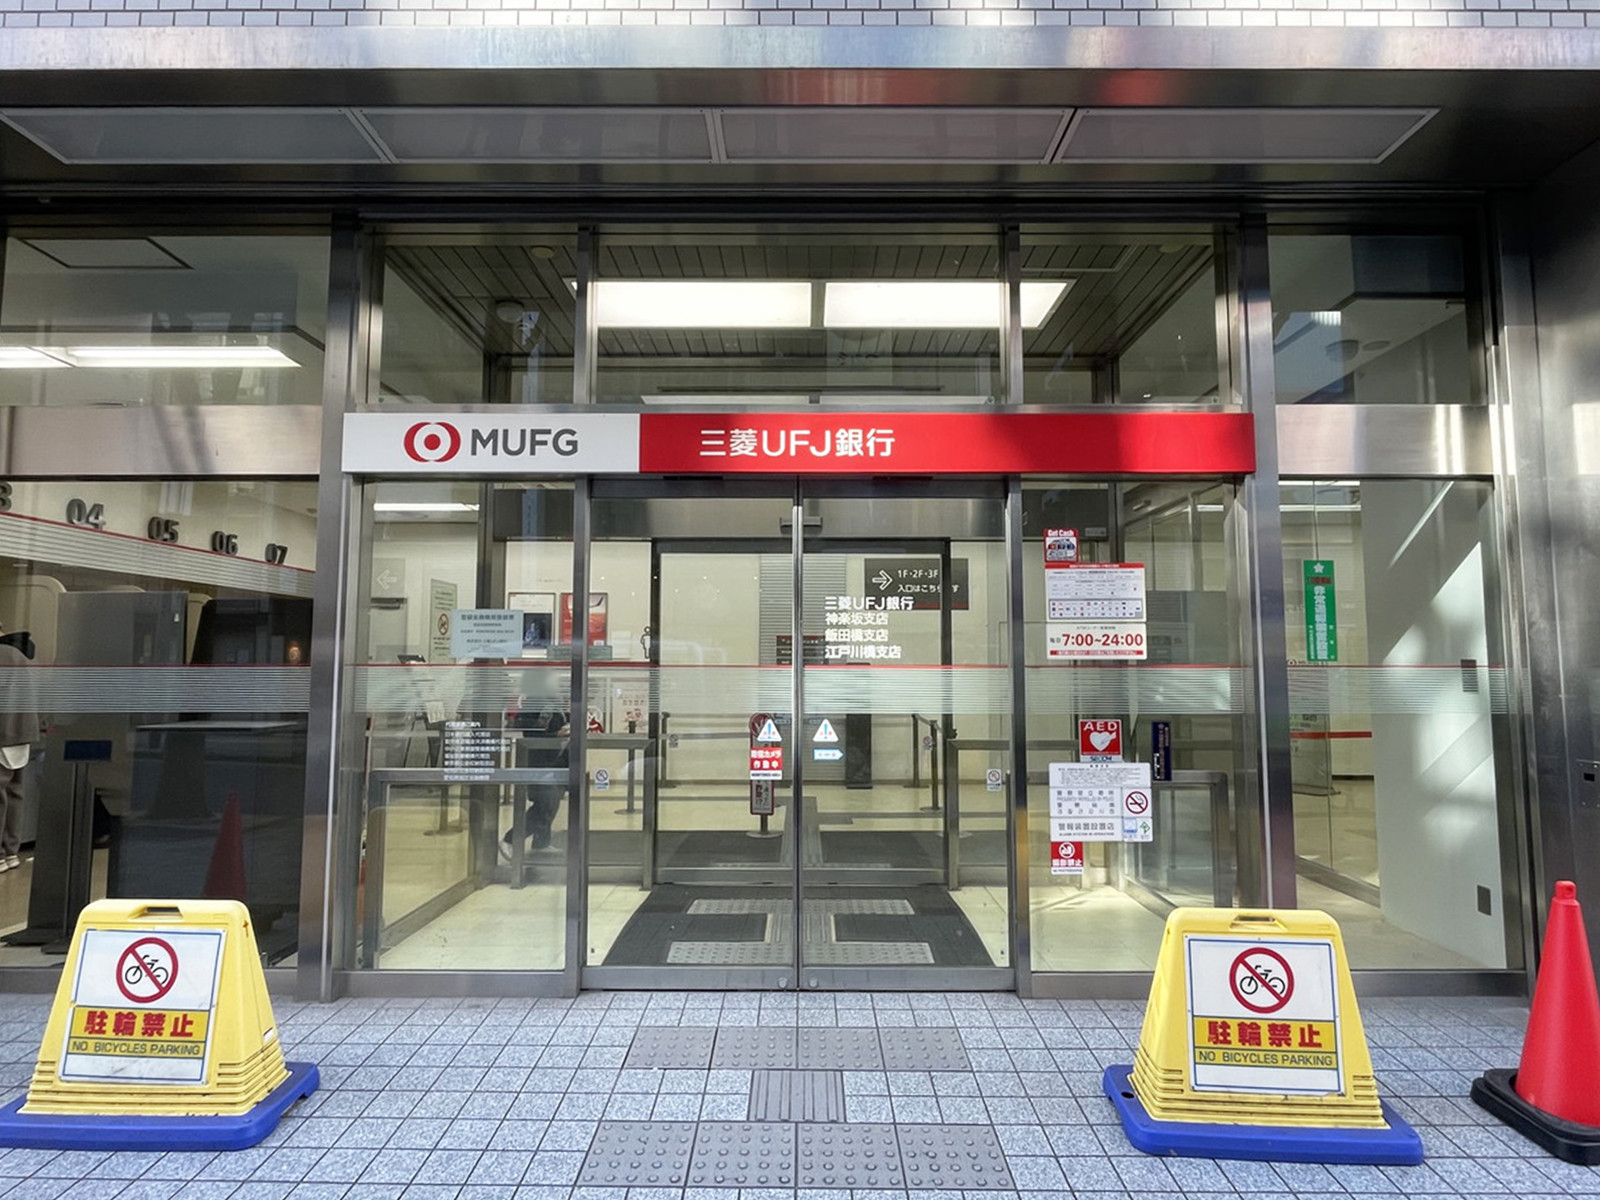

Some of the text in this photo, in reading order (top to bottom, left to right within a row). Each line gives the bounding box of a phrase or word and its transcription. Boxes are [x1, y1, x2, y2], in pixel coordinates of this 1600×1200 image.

[471, 429, 578, 456] MUFG
[700, 428, 895, 458] 三菱UFJ銀行
[66, 498, 105, 530] 04
[148, 516, 180, 544] 05
[211, 530, 239, 557] 06
[265, 543, 288, 565] 07
[824, 596, 914, 610] 三菱UFJ銀行
[825, 612, 888, 625] 神楽坂支店
[825, 628, 888, 642] 飯田橋支店
[825, 645, 901, 659] 江戸川橋支店
[1083, 721, 1118, 731] AED
[84, 1010, 194, 1038] 駐輪禁止
[1207, 1020, 1322, 1048] 駐輪禁止
[72, 1041, 200, 1055] NO BICYCLES PARKING
[1199, 1051, 1333, 1065] NO BICYCLES PARKING
